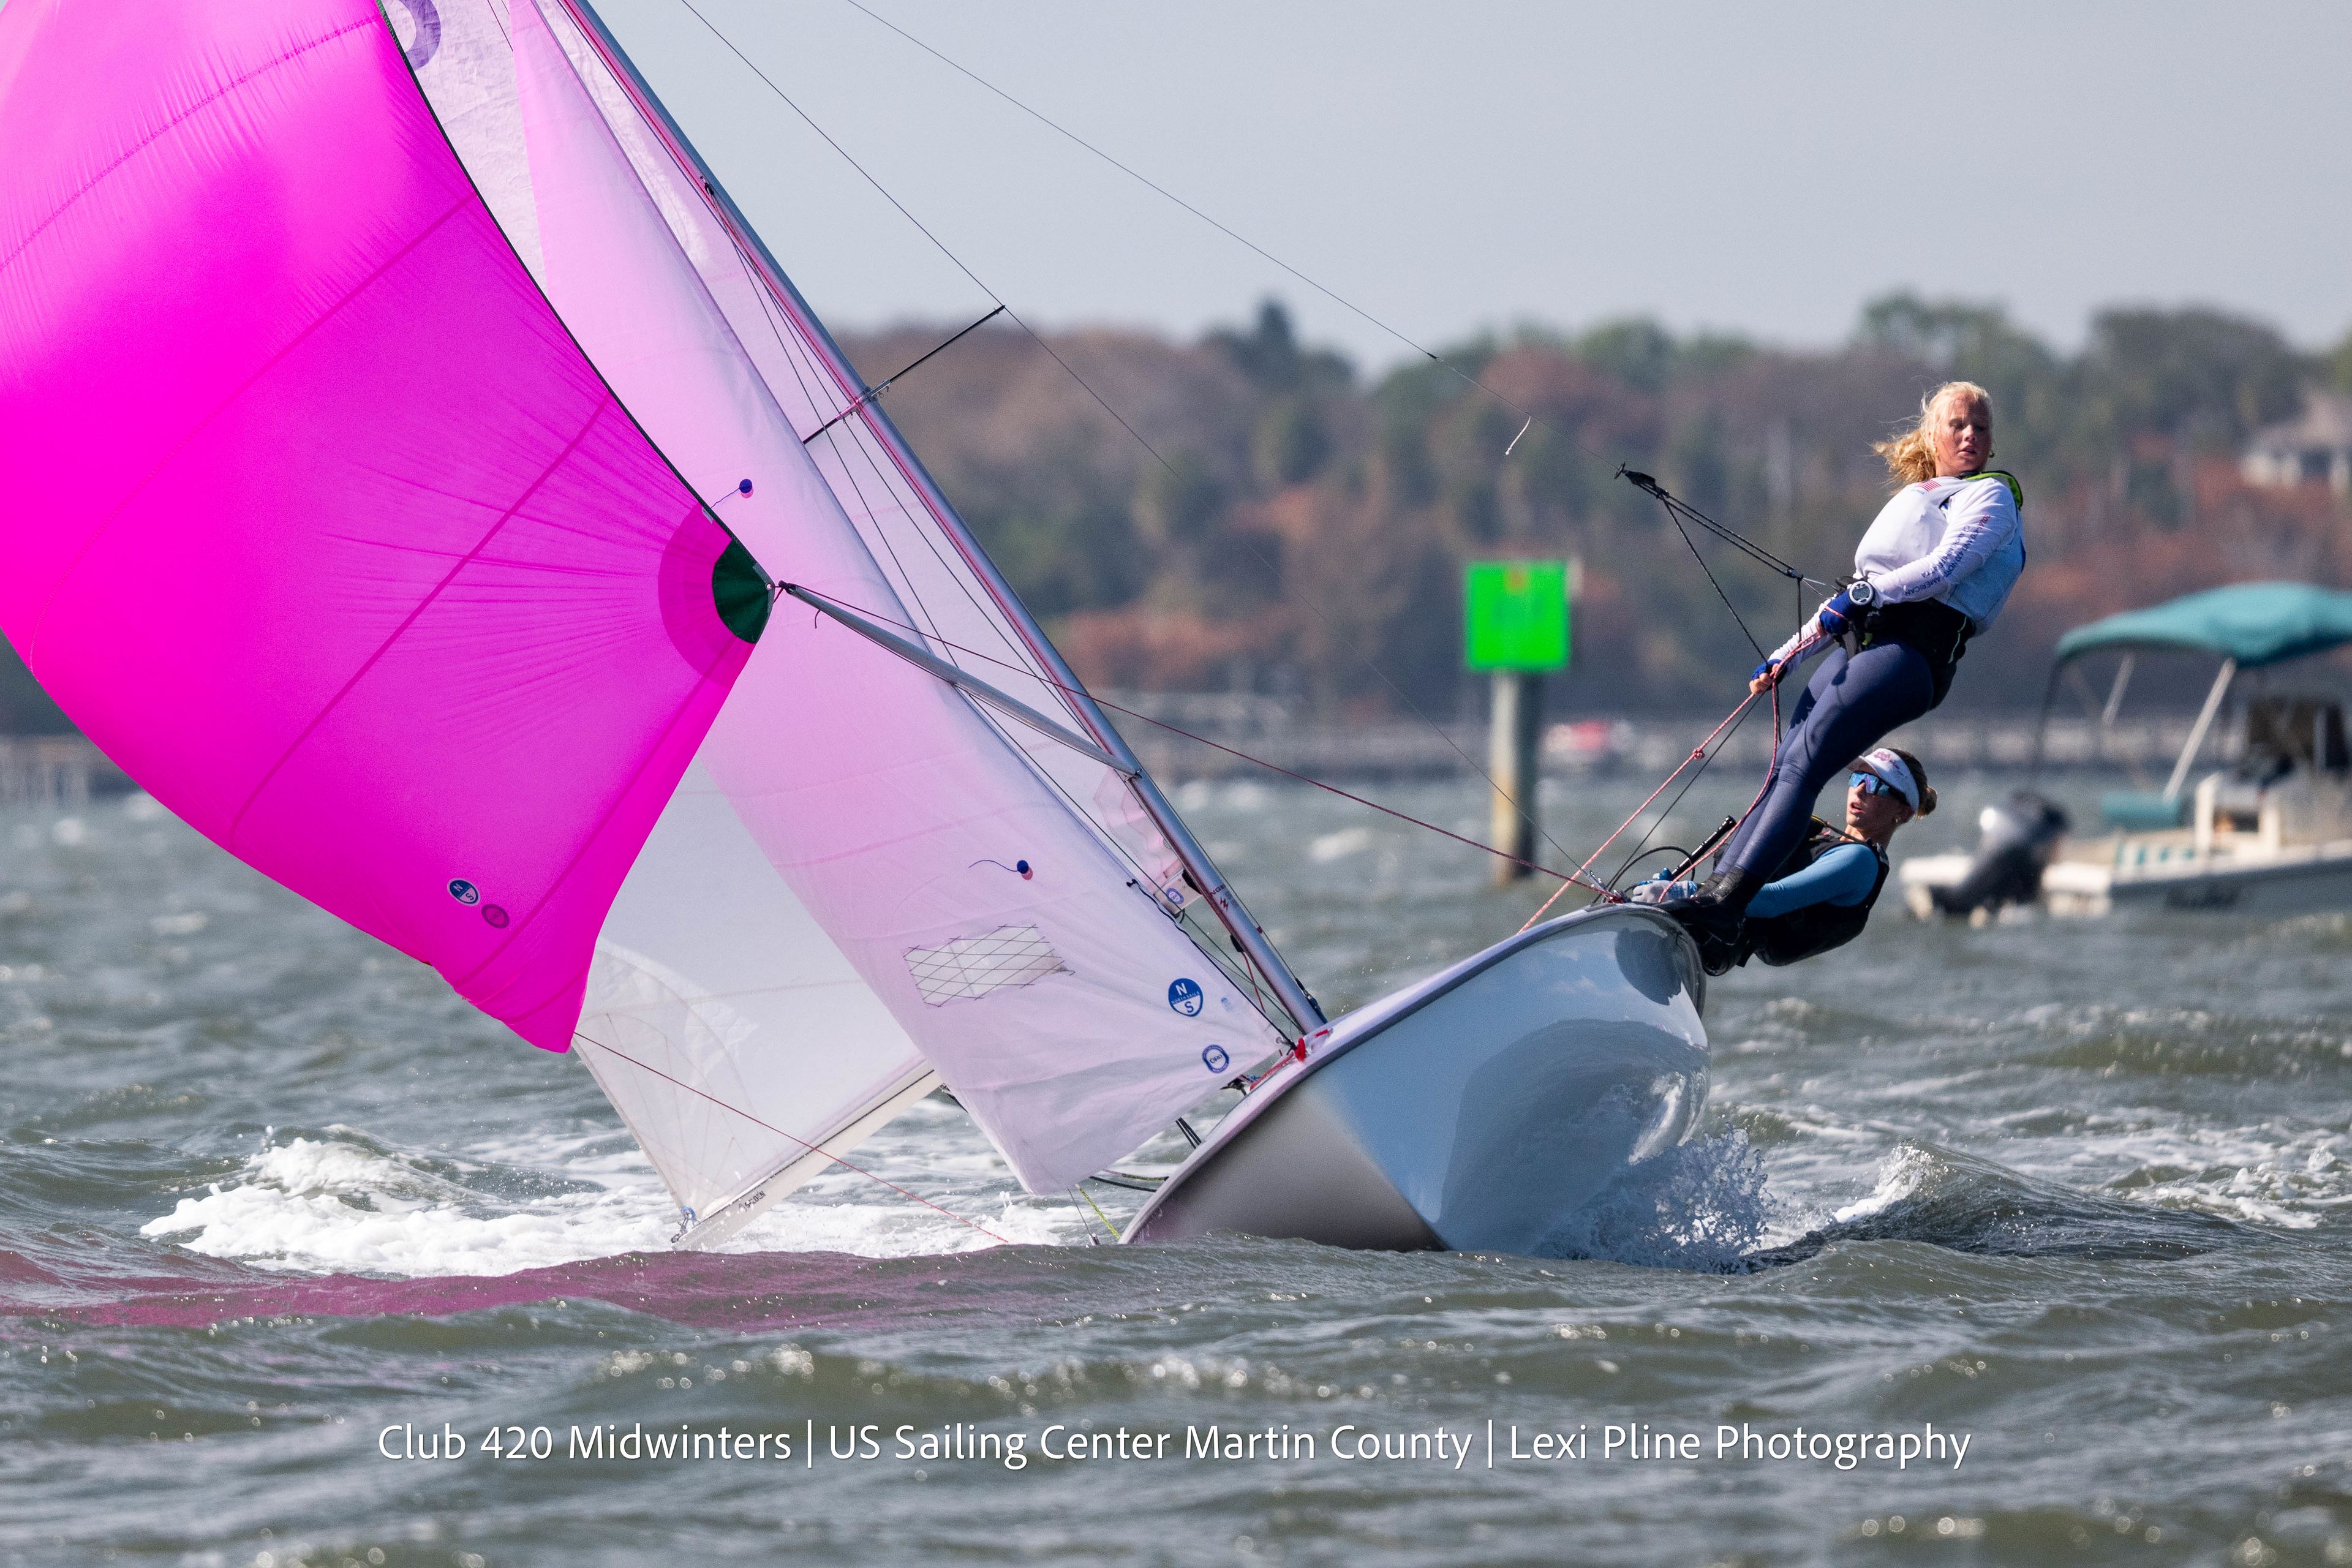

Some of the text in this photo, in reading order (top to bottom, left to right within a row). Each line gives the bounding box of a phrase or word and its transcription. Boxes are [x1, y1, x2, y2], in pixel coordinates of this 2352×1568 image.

[1904, 576, 1941, 597] AMERICAN
[1175, 982, 1187, 995] N
[1184, 1001, 1194, 1012] S
